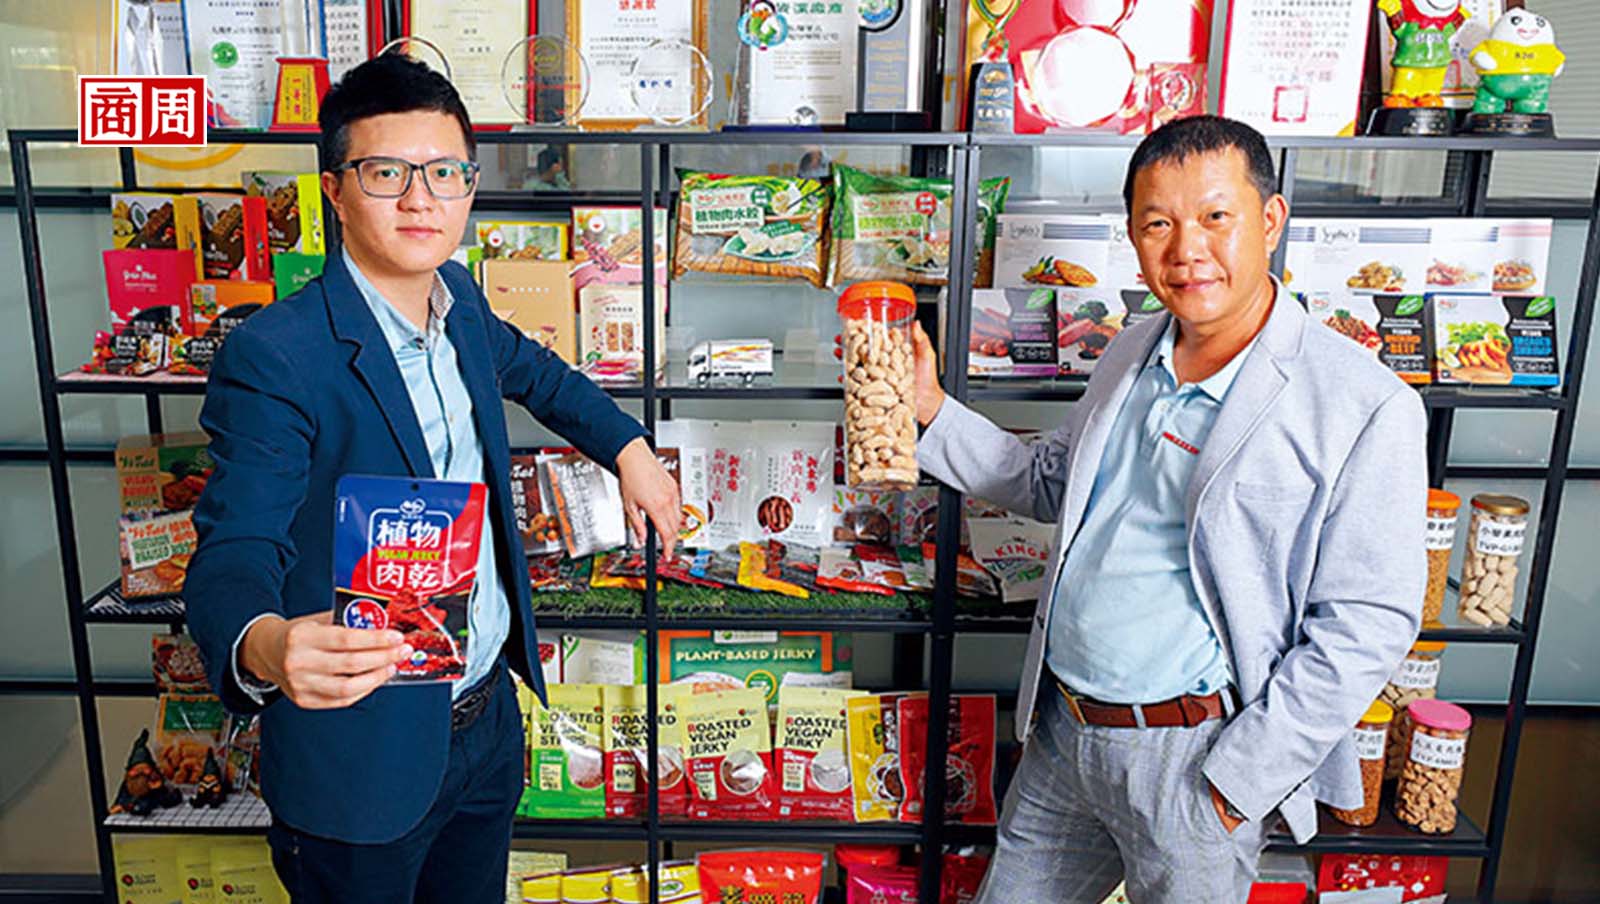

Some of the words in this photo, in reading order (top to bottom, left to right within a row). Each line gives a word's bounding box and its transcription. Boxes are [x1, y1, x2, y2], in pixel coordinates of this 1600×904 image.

[376, 519, 442, 549] 植物
[377, 550, 409, 560] VEGAN
[410, 550, 440, 561] JERKY
[376, 561, 441, 590] 肉乾
[675, 648, 770, 662] PLANT-BASED
[772, 648, 817, 661] JERKY
[687, 717, 752, 733] ROASTED
[689, 730, 737, 743] VEGAN
[785, 727, 833, 739] VEGAN
[690, 741, 730, 757] JERKY
[783, 737, 823, 749] JERKY
